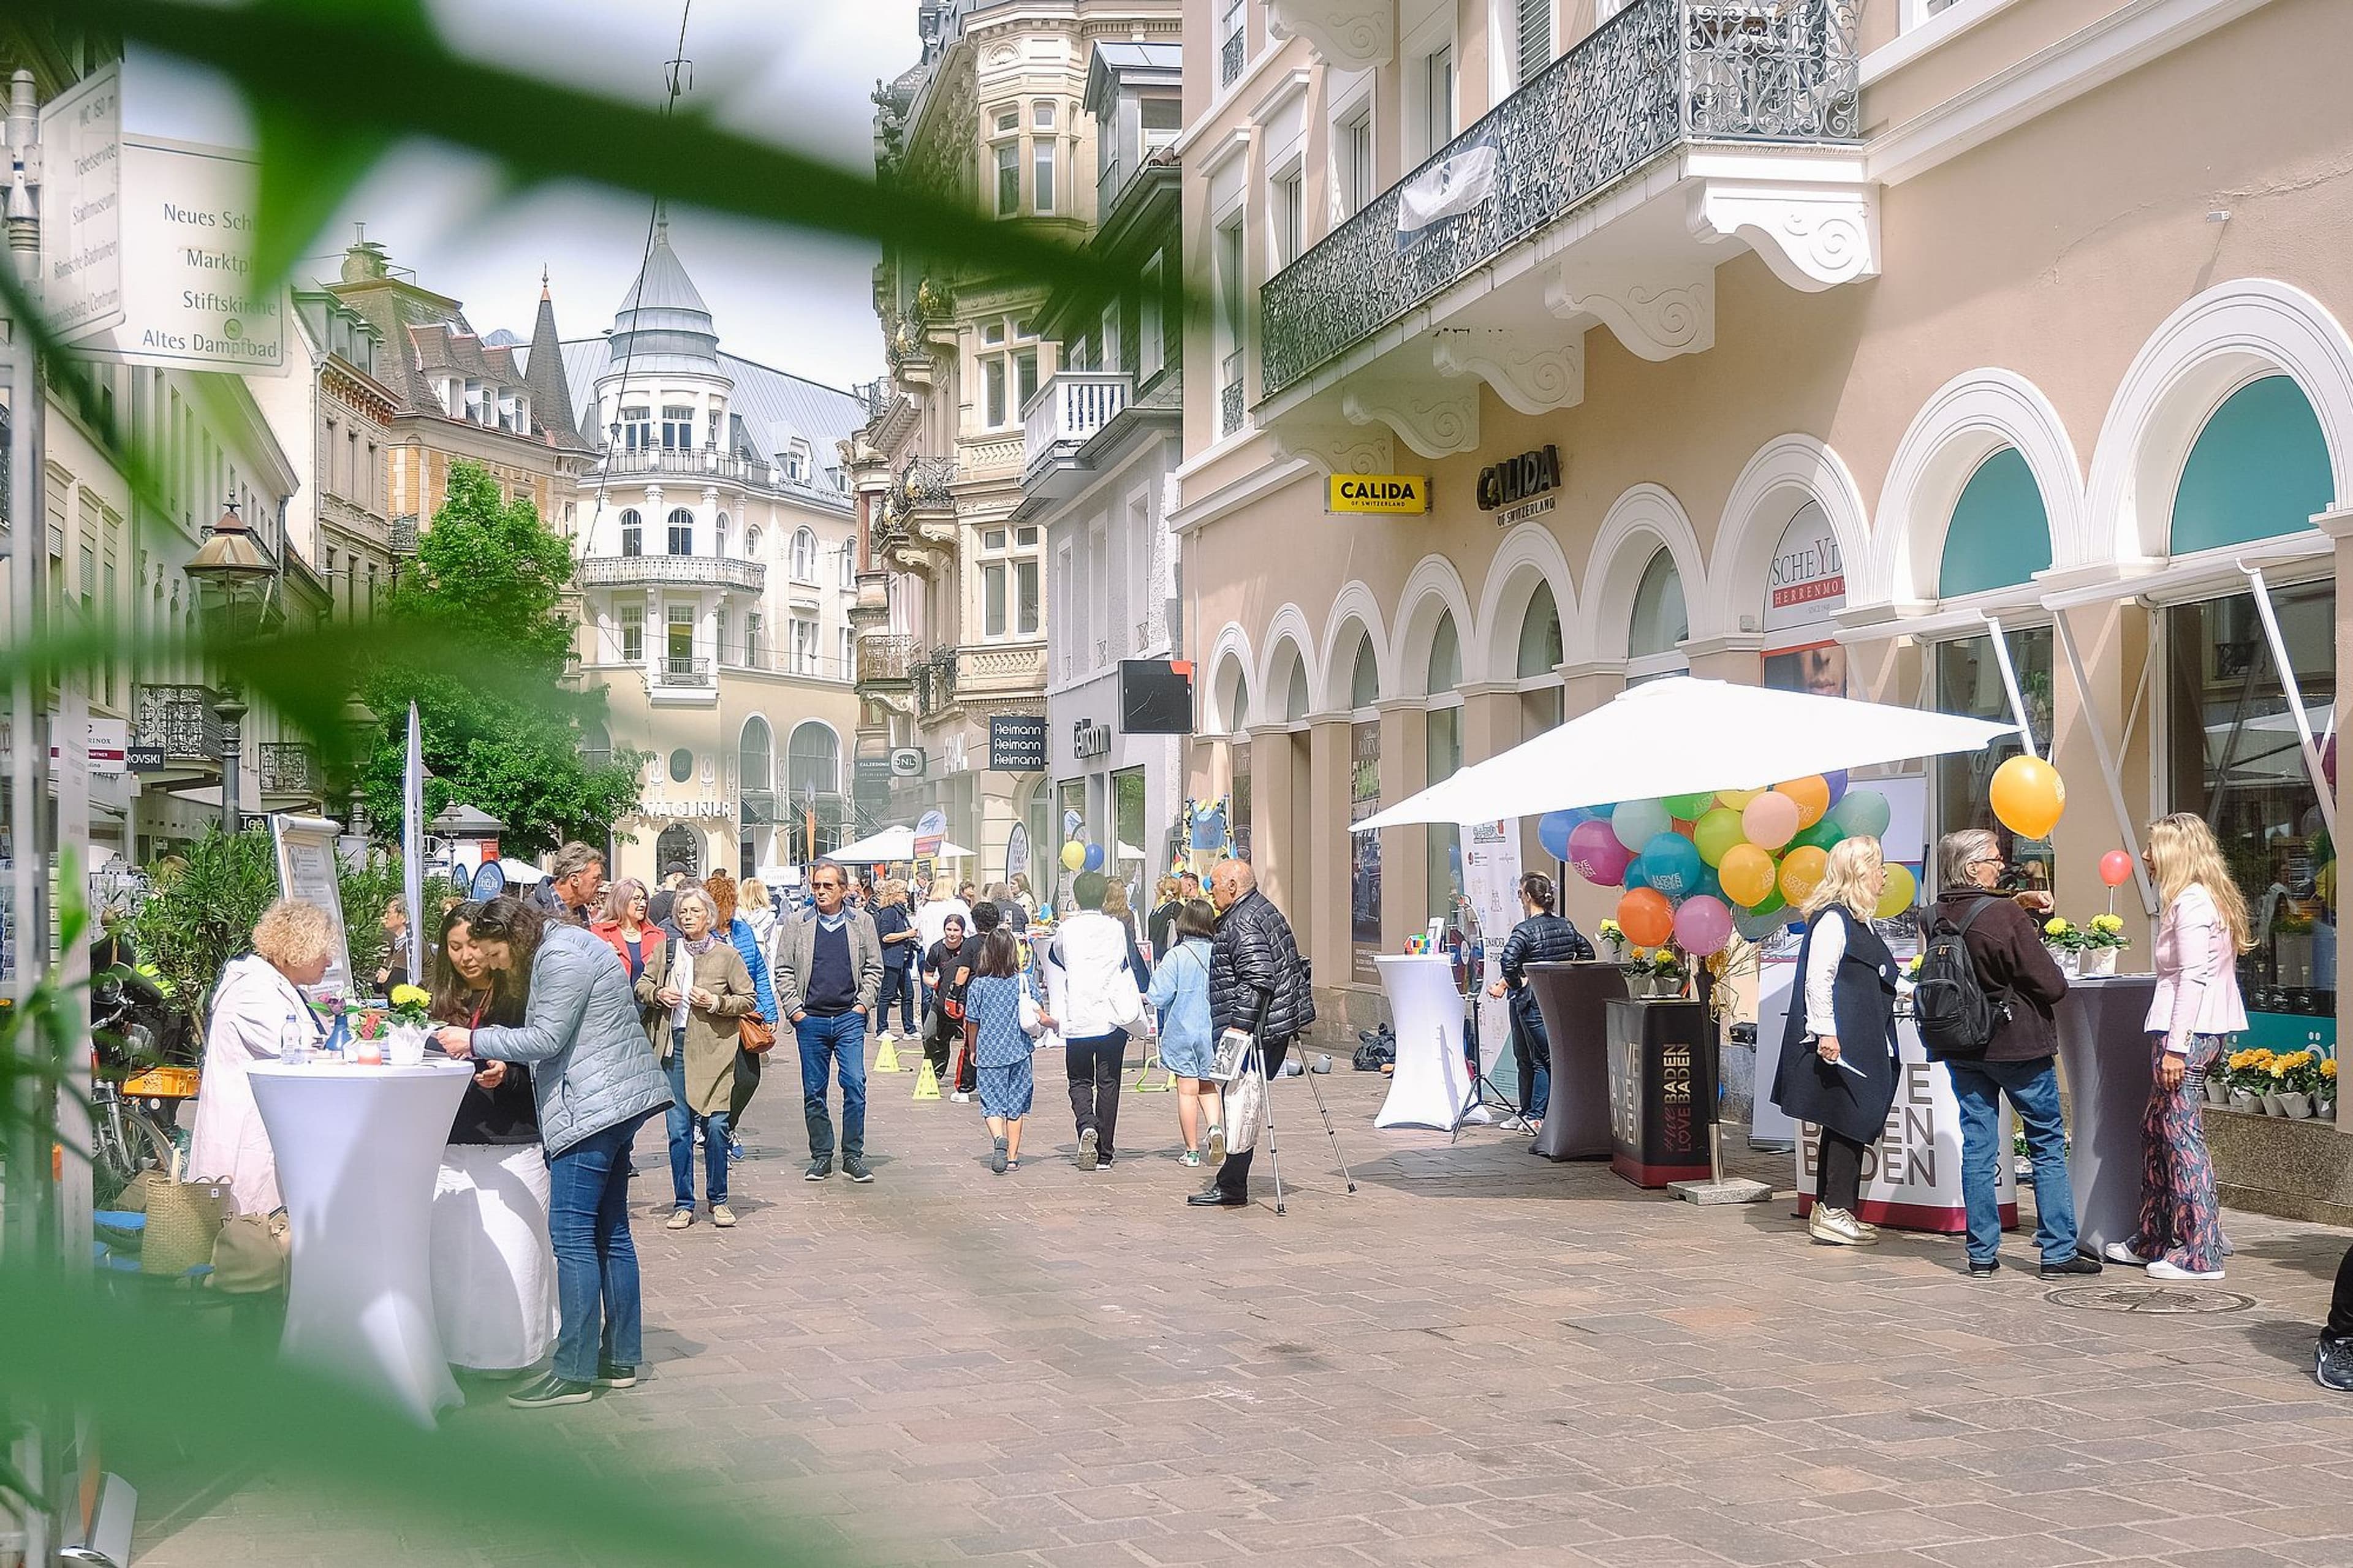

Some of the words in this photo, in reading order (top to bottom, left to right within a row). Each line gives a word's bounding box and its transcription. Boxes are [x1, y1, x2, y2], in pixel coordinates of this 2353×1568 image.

[163, 203, 216, 227] Neues
[222, 211, 254, 232] Sch
[186, 249, 255, 276] Marktpl
[183, 290, 276, 316] Stiftskirhe
[143, 329, 186, 349] Altes
[193, 333, 276, 358] Dampfbad
[1341, 482, 1415, 499] CALIDA
[1477, 445, 1561, 510] CALIDA
[1498, 513, 1506, 526] OF
[1507, 498, 1555, 523] SWITZERLAND
[1772, 537, 1843, 585] SCHEYD
[1663, 1043, 1677, 1104] BADEN
[1677, 1043, 1691, 1104] BADEN
[1611, 1075, 1642, 1112] ADEN
[1611, 1107, 1642, 1145] ADEN
[1803, 1140, 1936, 1187] BDEN
